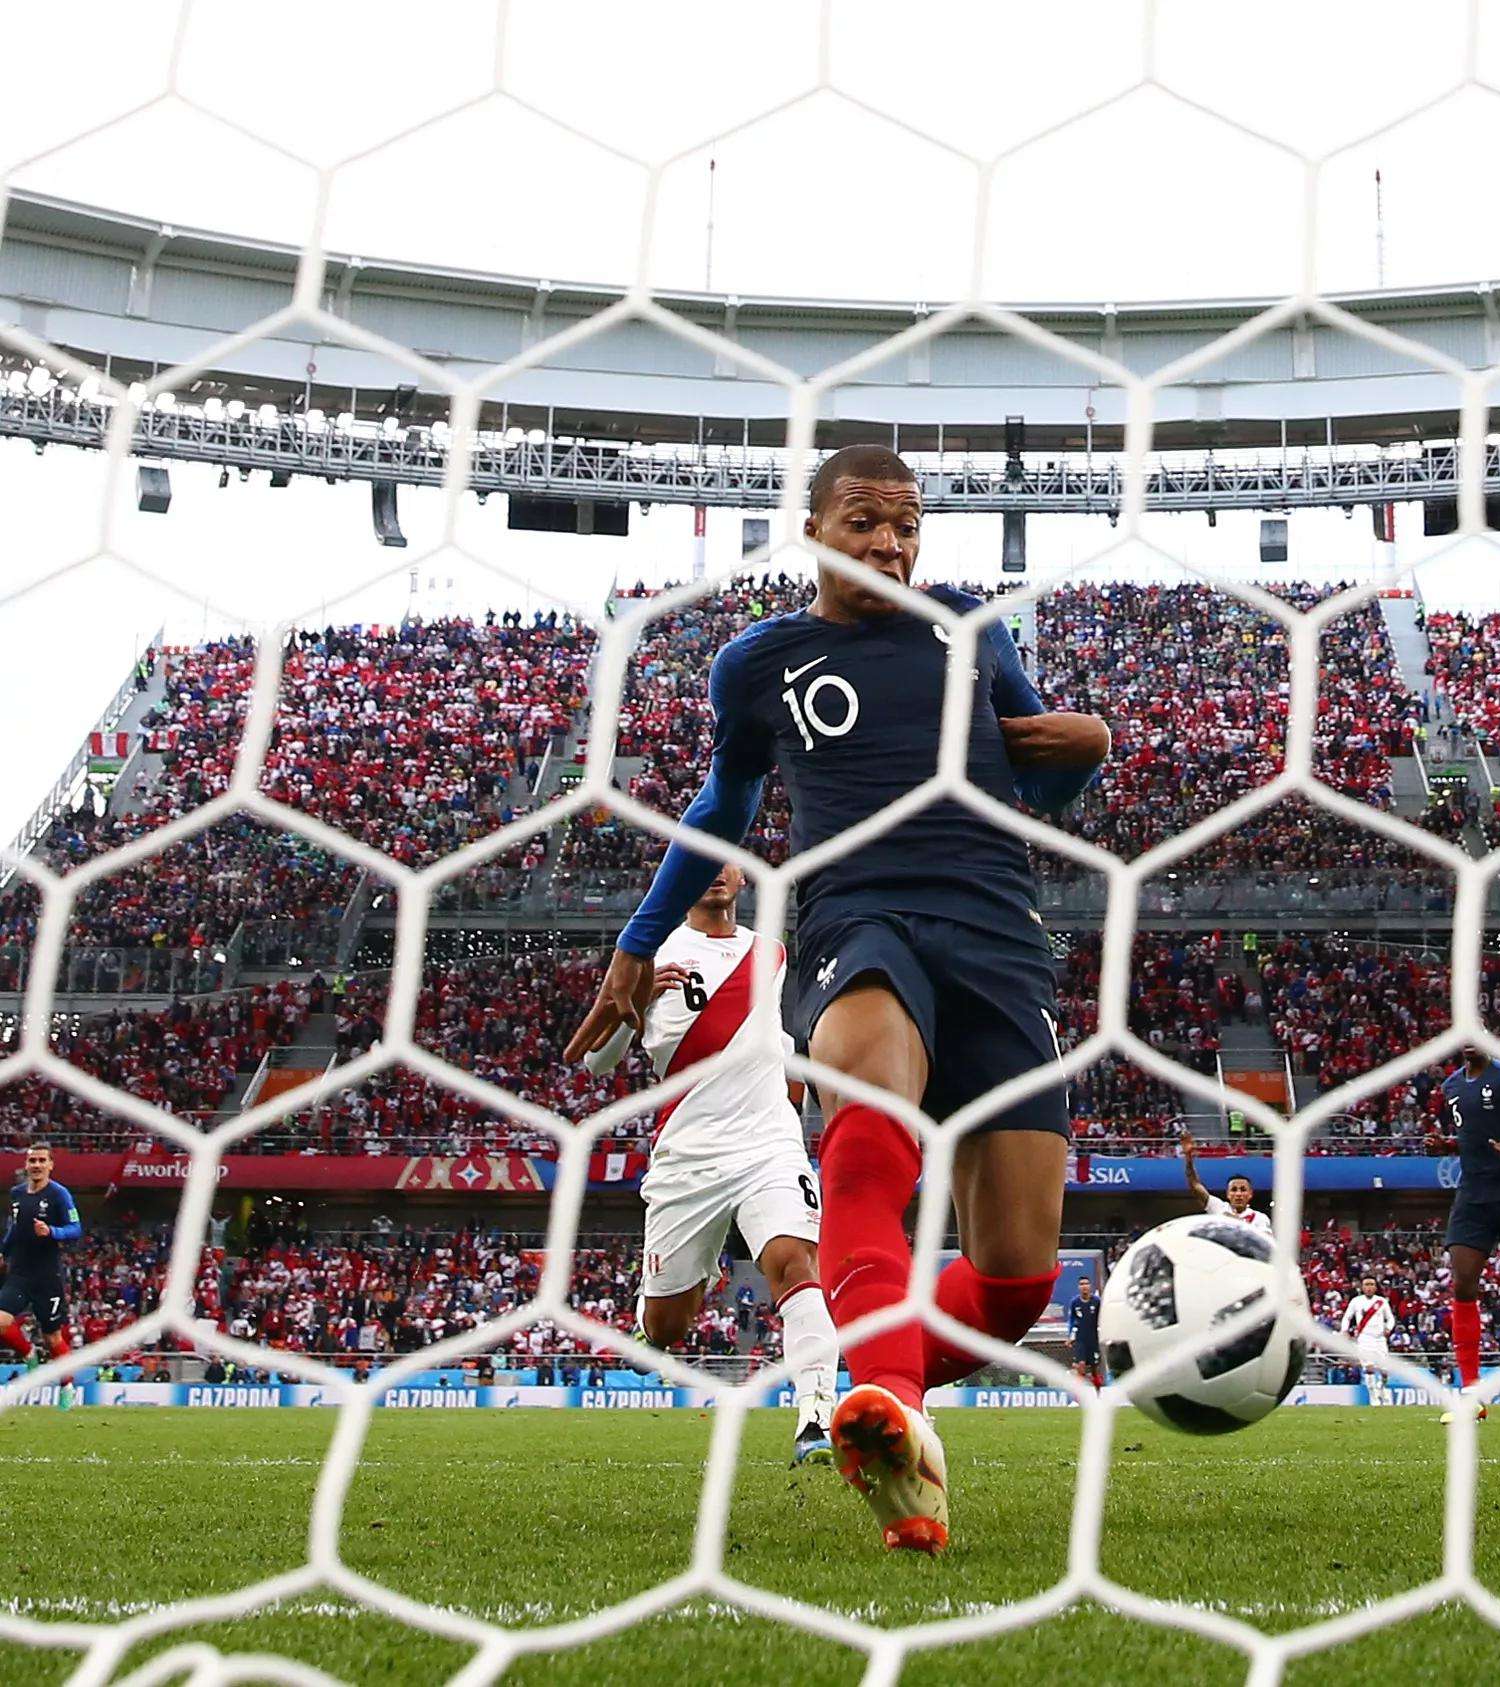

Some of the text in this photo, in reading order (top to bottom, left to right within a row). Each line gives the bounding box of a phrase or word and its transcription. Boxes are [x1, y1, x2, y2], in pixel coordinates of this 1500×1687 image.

[782, 674, 859, 751] 10
[683, 971, 707, 1012] 6
[1452, 1104, 1462, 1127] 6
[798, 1174, 818, 1210] 6
[50, 1297, 60, 1314] 7
[188, 1387, 280, 1407] GAZPROM
[385, 1388, 476, 1408] GAZPROM
[582, 1390, 673, 1408] GAZPROM
